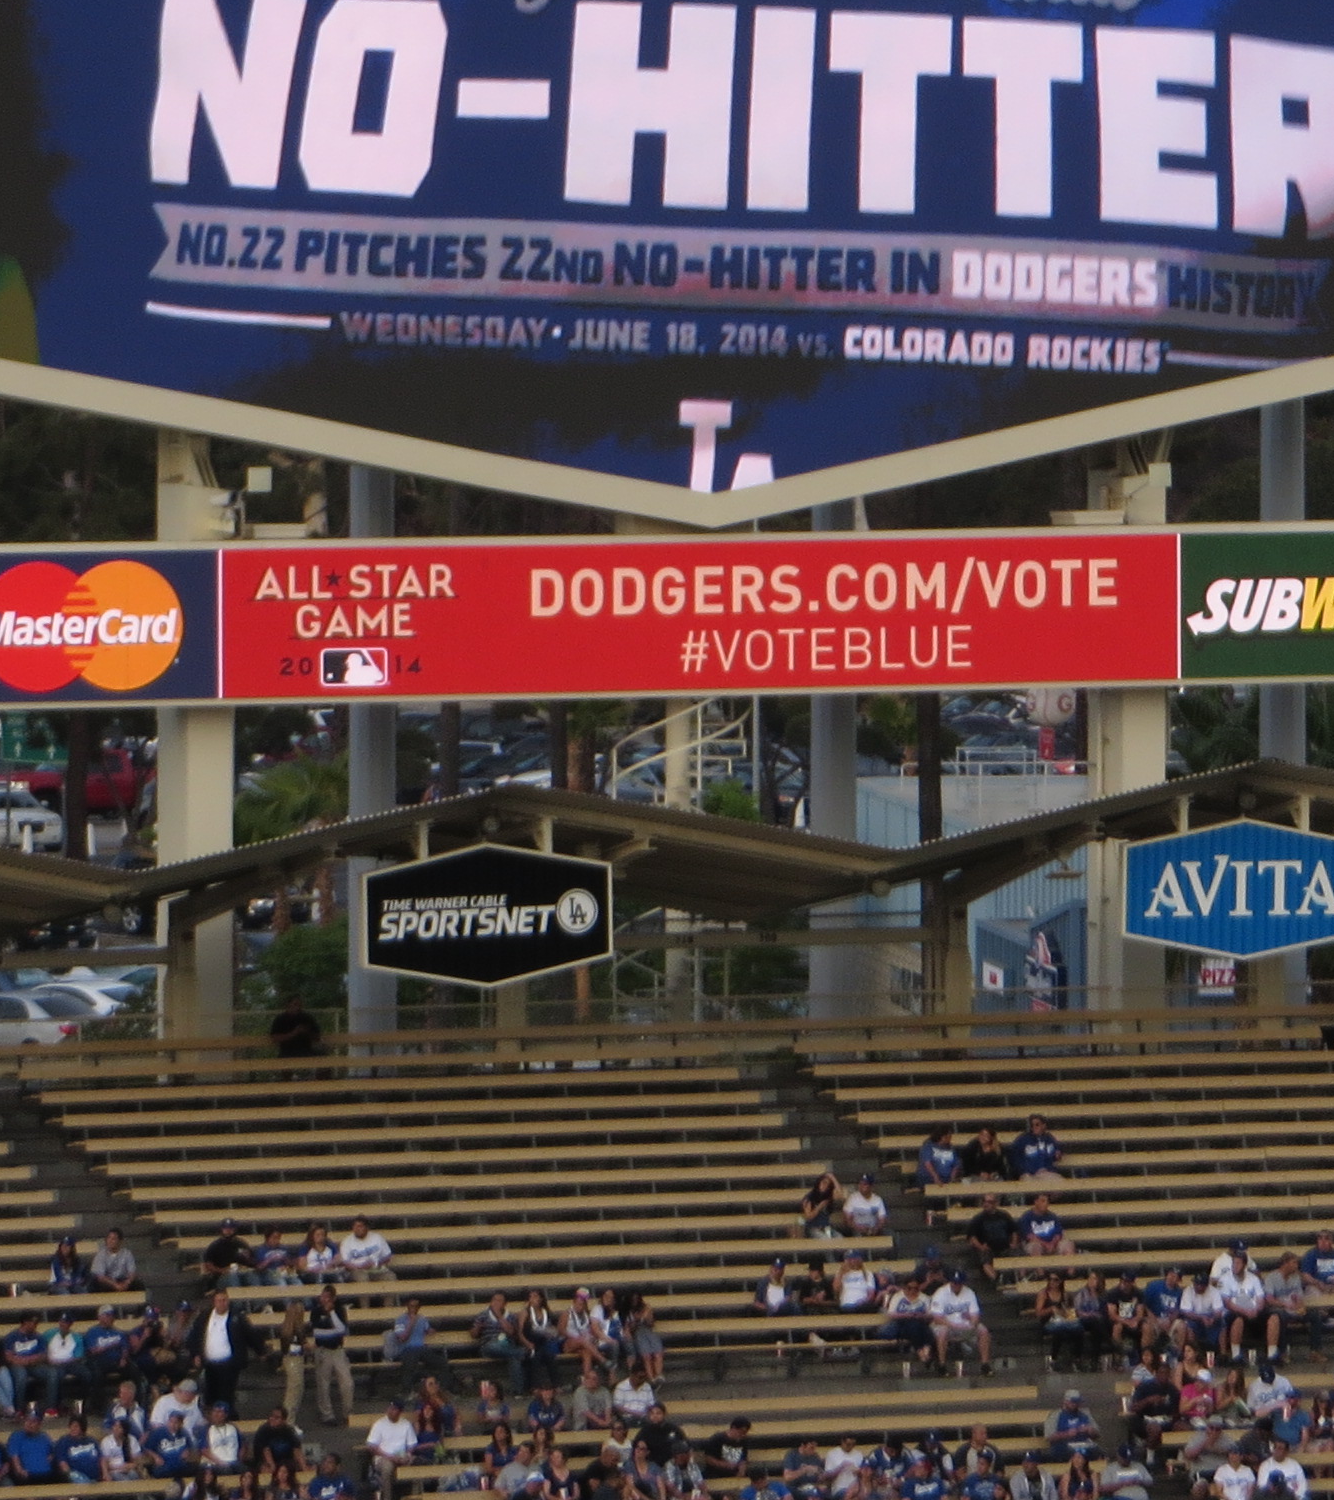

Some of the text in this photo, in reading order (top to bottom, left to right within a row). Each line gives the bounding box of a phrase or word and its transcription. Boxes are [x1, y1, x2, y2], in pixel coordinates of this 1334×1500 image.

[176, 222, 285, 271] NO.22
[294, 228, 487, 280] PITCHES
[612, 241, 879, 295] NO-HITTER
[890, 250, 941, 296] IN
[951, 249, 1160, 307] DODGERS
[1168, 264, 1318, 320] HISTORY
[341, 310, 545, 349] WEDNESDAY
[568, 317, 651, 351] JUNE
[665, 322, 707, 357] 18,
[719, 323, 788, 358] 2014
[844, 324, 1014, 368] COLORADO
[1027, 335, 1162, 374] ROCKIES
[254, 563, 456, 601] ALL STAR
[529, 556, 1119, 619] DODGERS.COM/VOTE
[295, 603, 415, 639] GAME
[279, 656, 314, 678] 20
[680, 624, 973, 673] #VOTEBLUE
[382, 893, 508, 912] TIME WARNER CABLE
[569, 896, 587, 925] LA
[378, 904, 557, 941] SPORTSNET
[1200, 968, 1237, 986] PIZZ
